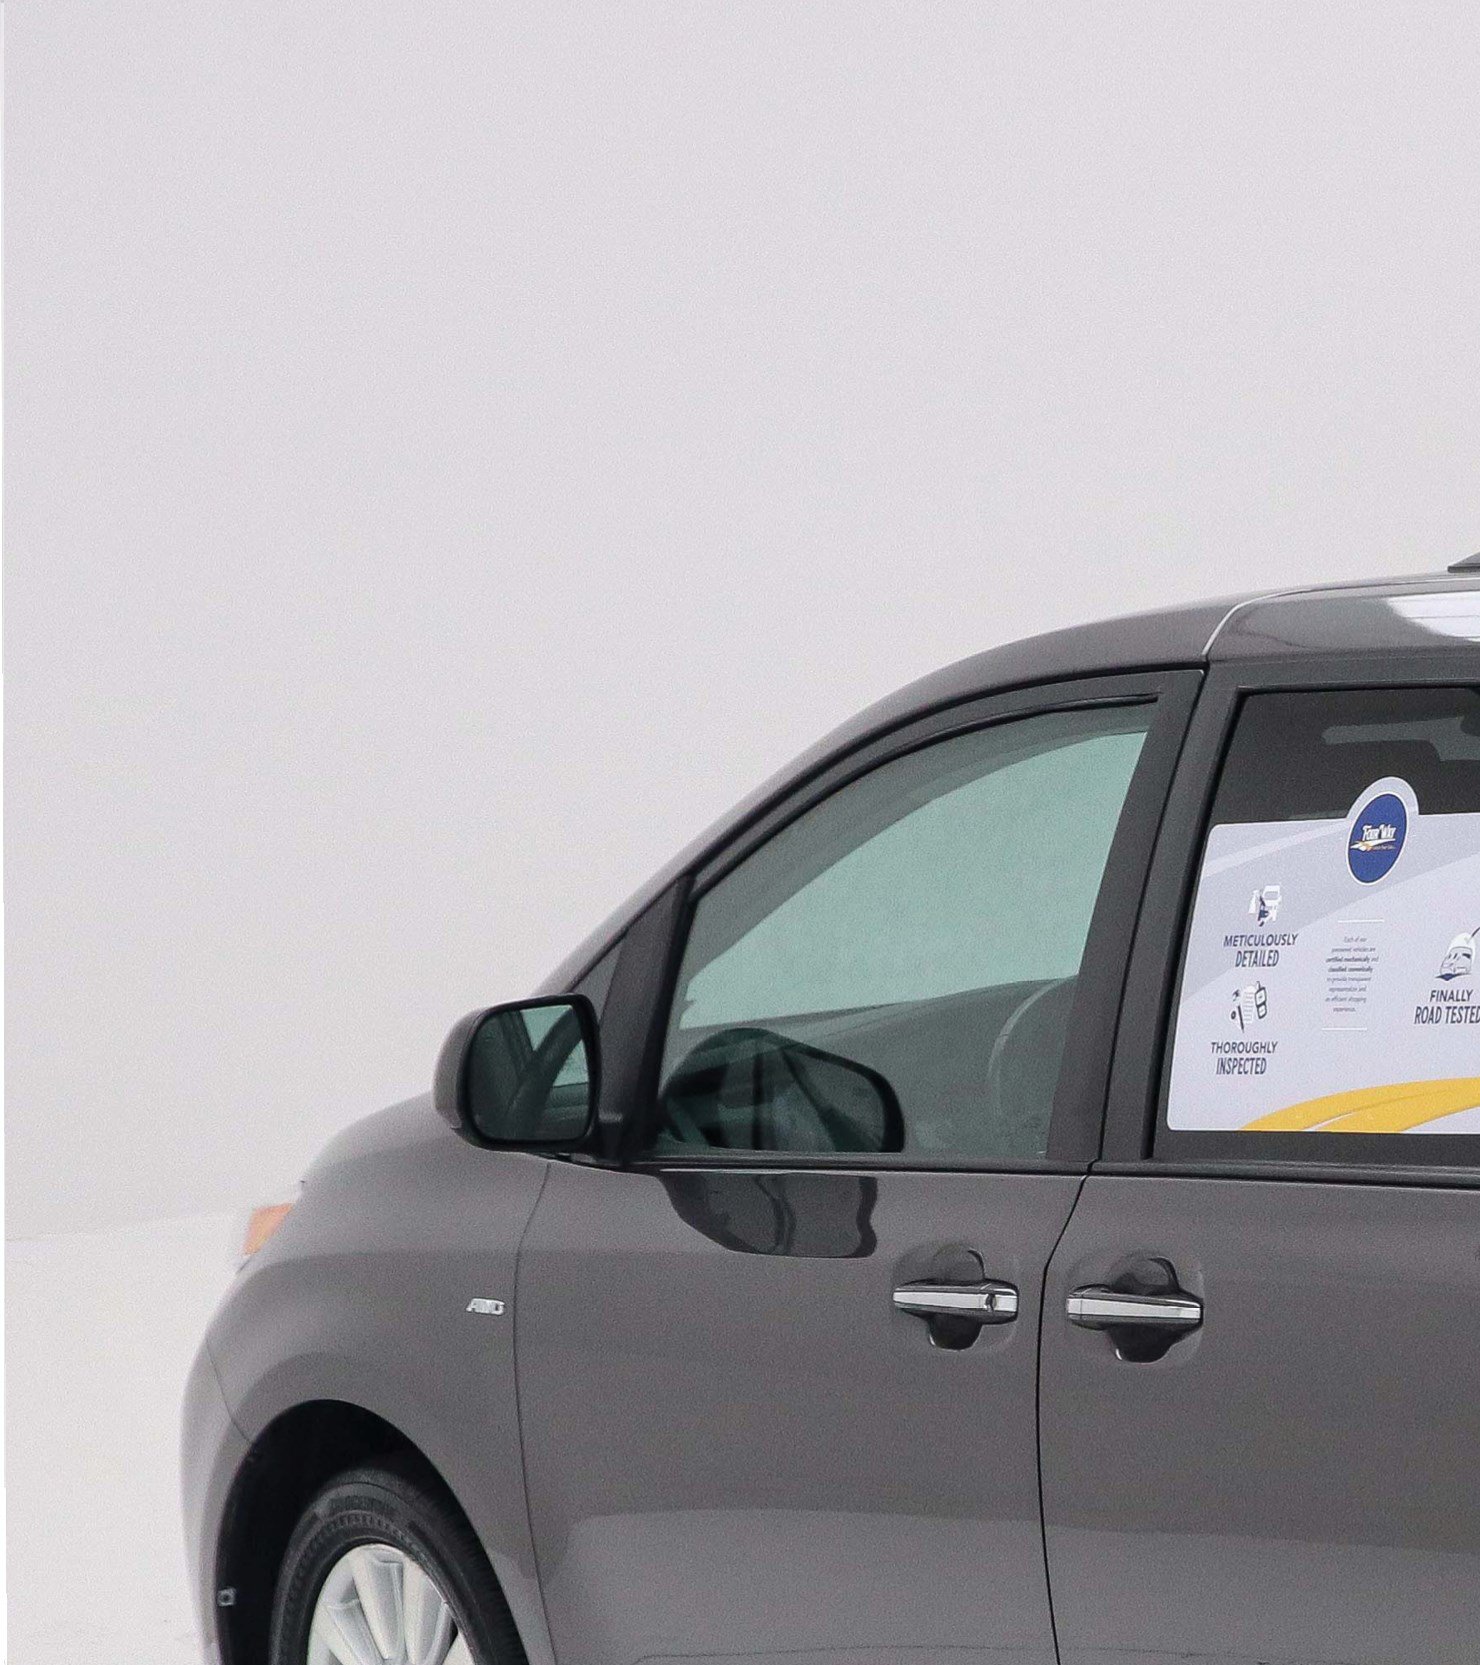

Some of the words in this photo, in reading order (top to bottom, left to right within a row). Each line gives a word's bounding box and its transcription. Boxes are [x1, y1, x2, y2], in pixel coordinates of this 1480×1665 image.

[1223, 933, 1299, 947] METICULOUSLY
[1235, 949, 1280, 968] DETAILED
[1430, 989, 1474, 1002] FINALLY
[1414, 1006, 1442, 1024] ROAD
[1211, 1041, 1278, 1054] THOROUGHLY
[1216, 1057, 1267, 1075] INSPECTED
